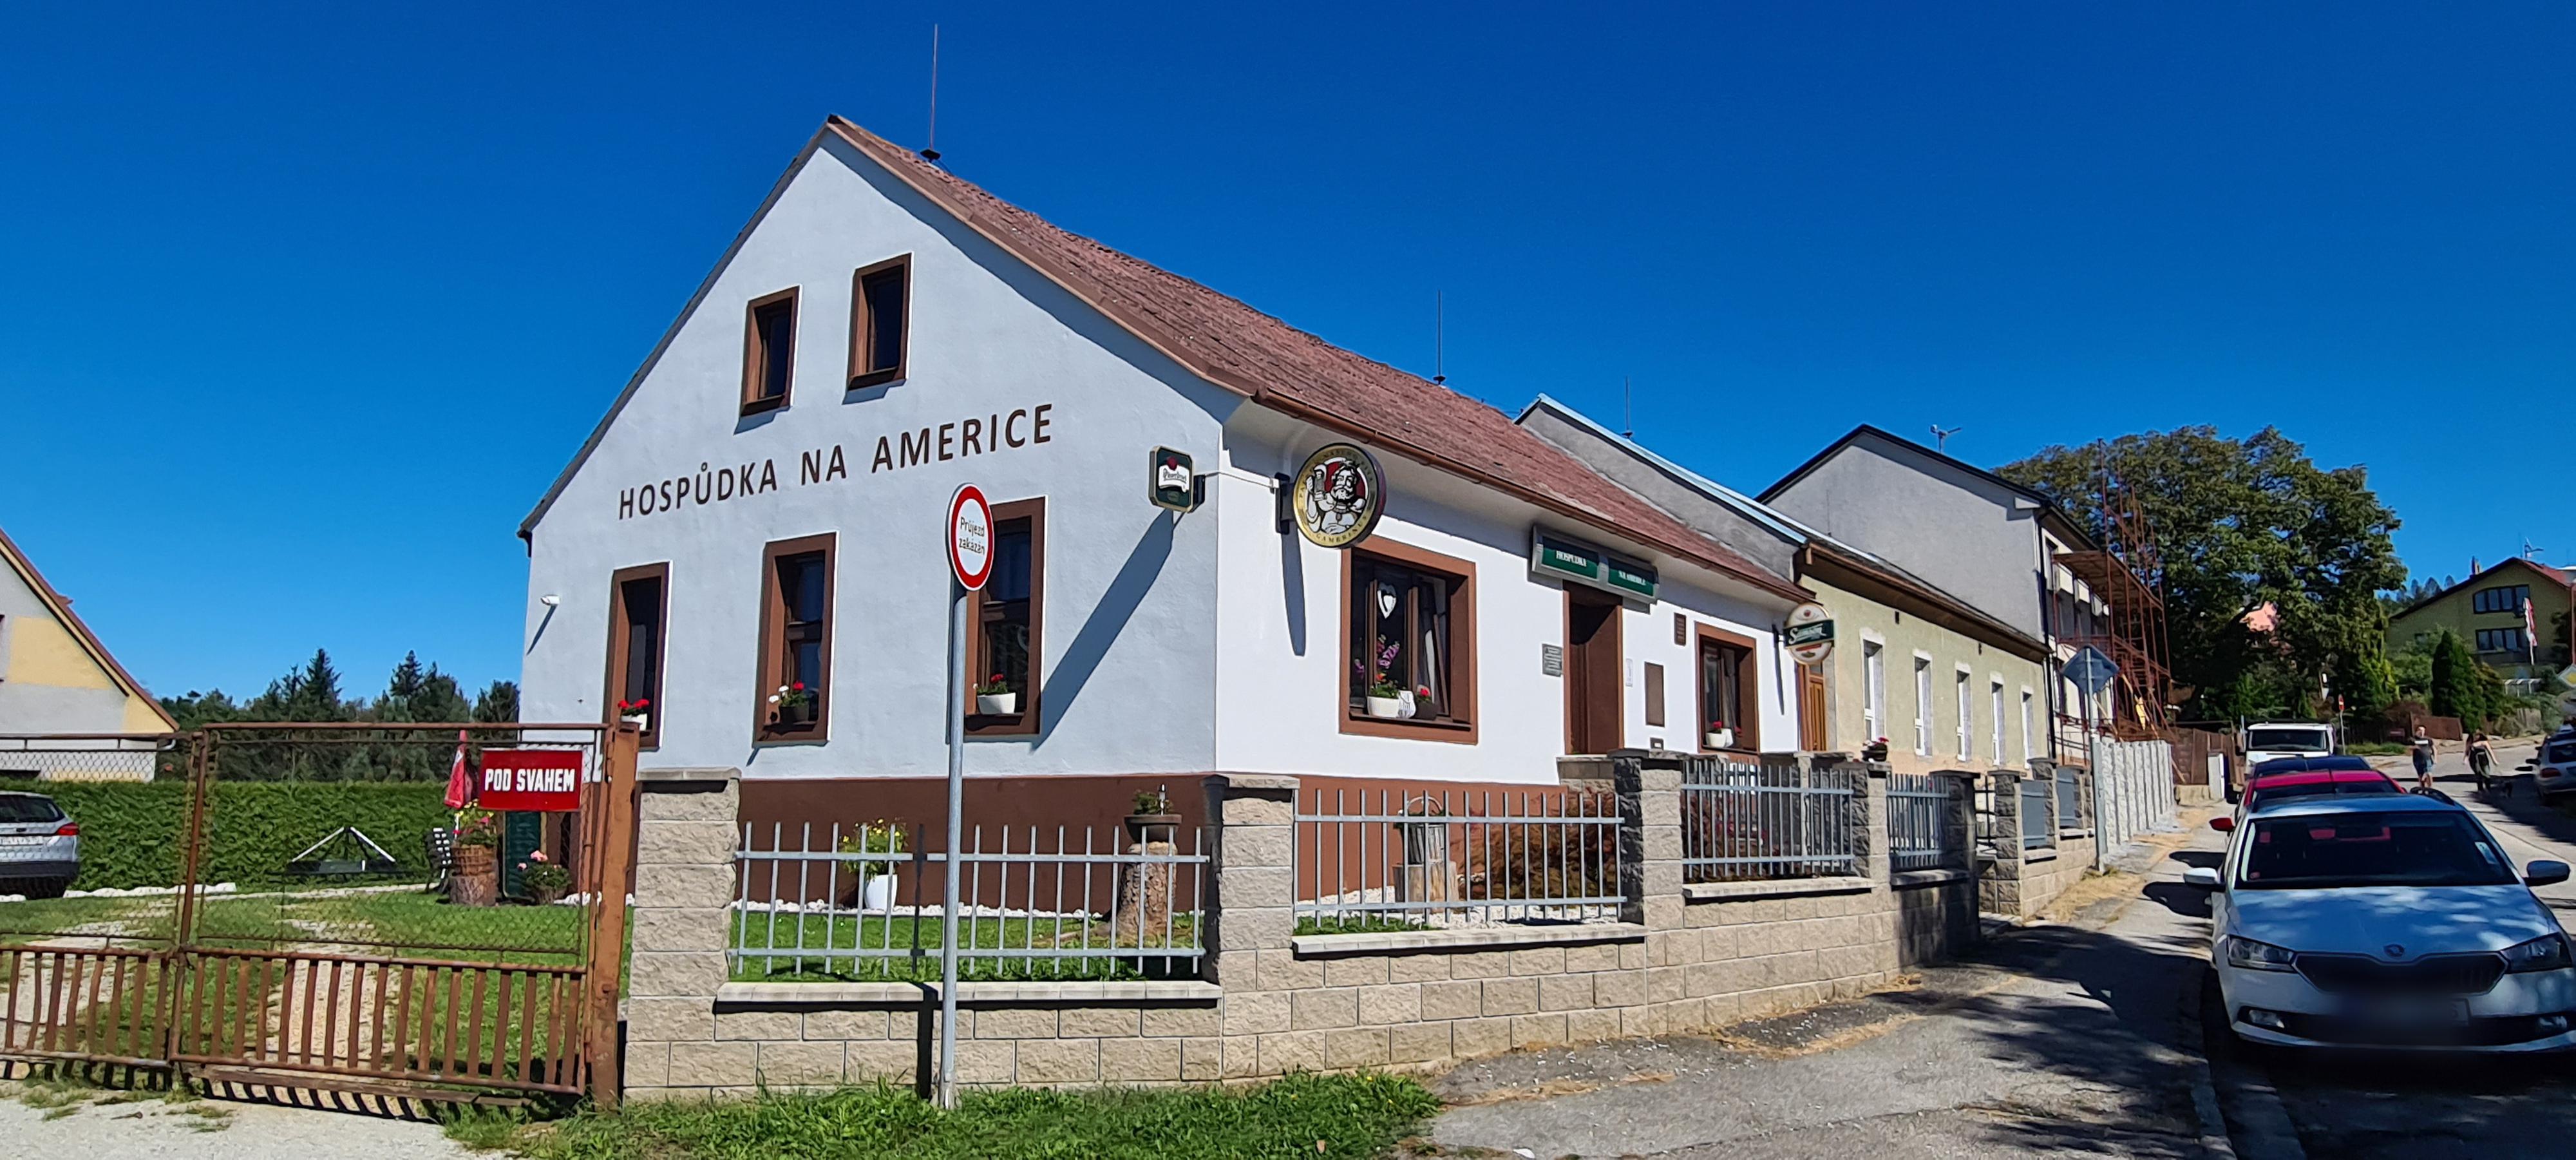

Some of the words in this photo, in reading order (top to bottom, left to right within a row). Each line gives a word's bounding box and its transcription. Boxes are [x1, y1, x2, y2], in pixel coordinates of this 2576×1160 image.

[619, 459, 777, 520] HOSPŮDKA
[801, 444, 847, 486] NA
[871, 404, 1052, 473] AMERICE
[960, 517, 985, 537] Průjezd
[1316, 516, 1367, 542] GAMBRINUS
[959, 537, 985, 555] zakázán
[484, 768, 512, 792] POD
[516, 768, 575, 792] SVAHEM
